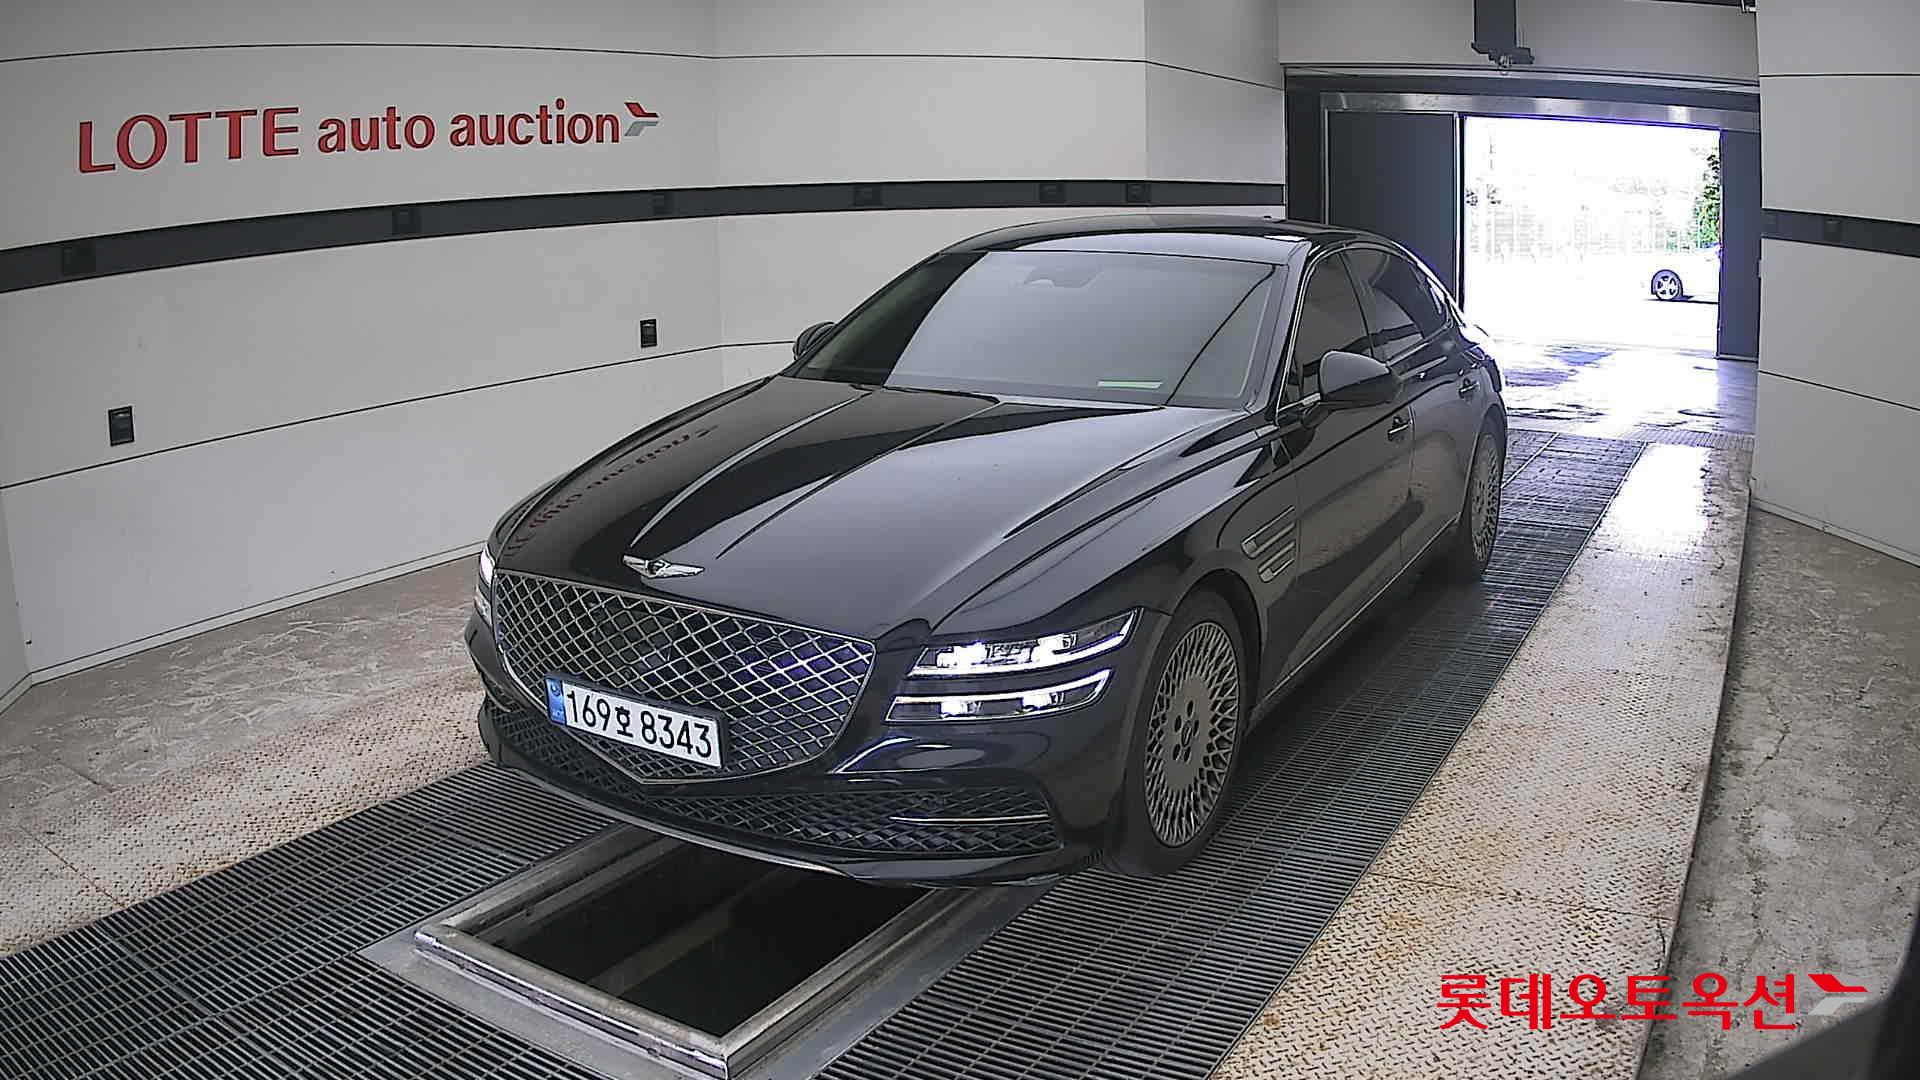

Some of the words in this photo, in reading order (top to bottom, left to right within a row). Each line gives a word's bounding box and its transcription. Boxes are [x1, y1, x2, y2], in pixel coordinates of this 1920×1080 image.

[78, 106, 299, 173] LOTTE
[317, 106, 436, 154] auto
[449, 98, 620, 146] auction
[566, 690, 634, 738] 169호
[640, 710, 712, 759] 8343
